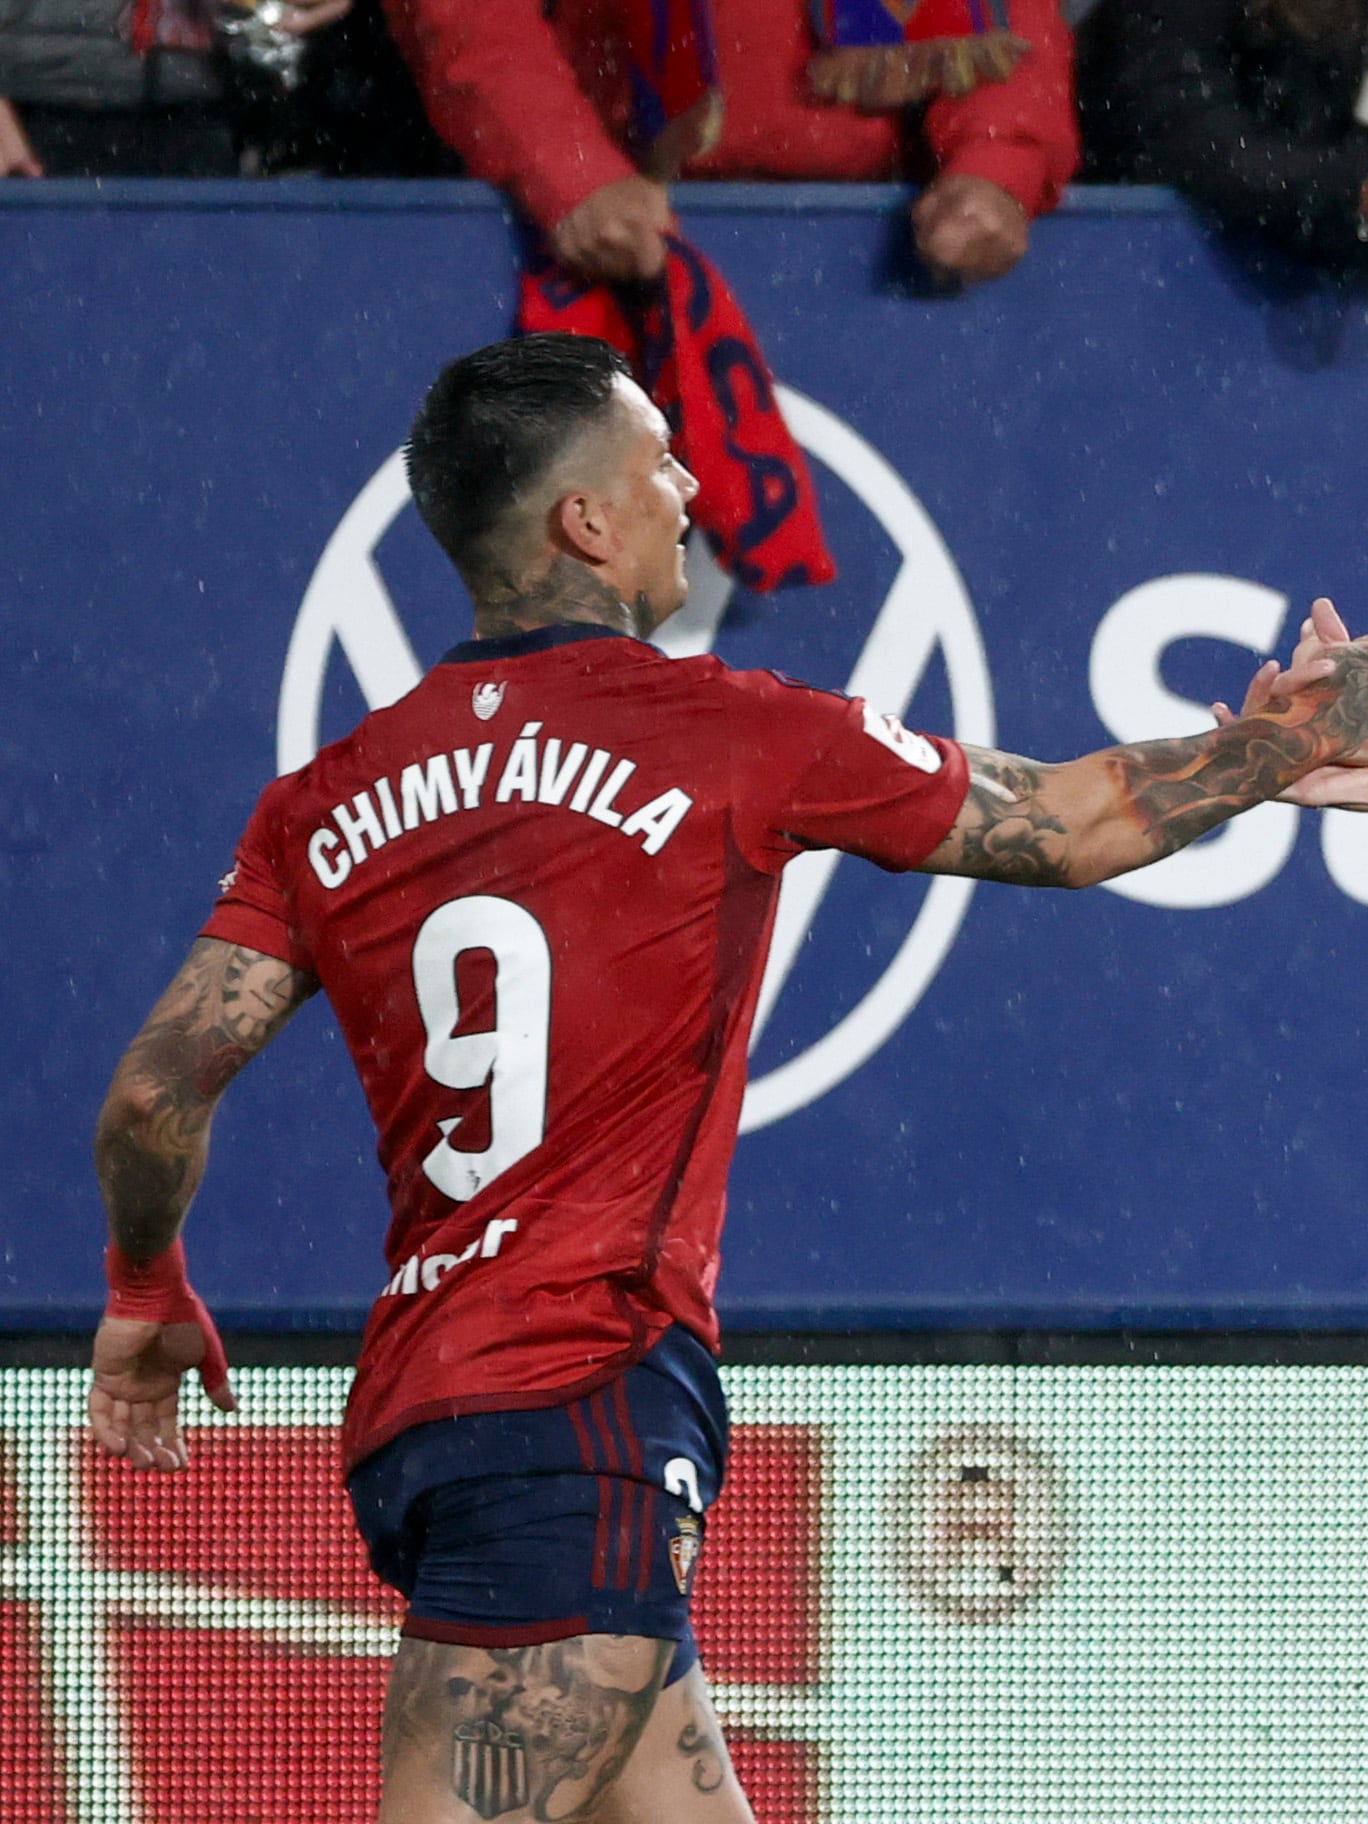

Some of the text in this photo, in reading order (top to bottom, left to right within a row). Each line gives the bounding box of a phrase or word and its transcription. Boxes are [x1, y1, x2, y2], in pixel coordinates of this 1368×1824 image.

[308, 716, 693, 889] CHIMY ÁVILA
[412, 894, 552, 1202] 9
